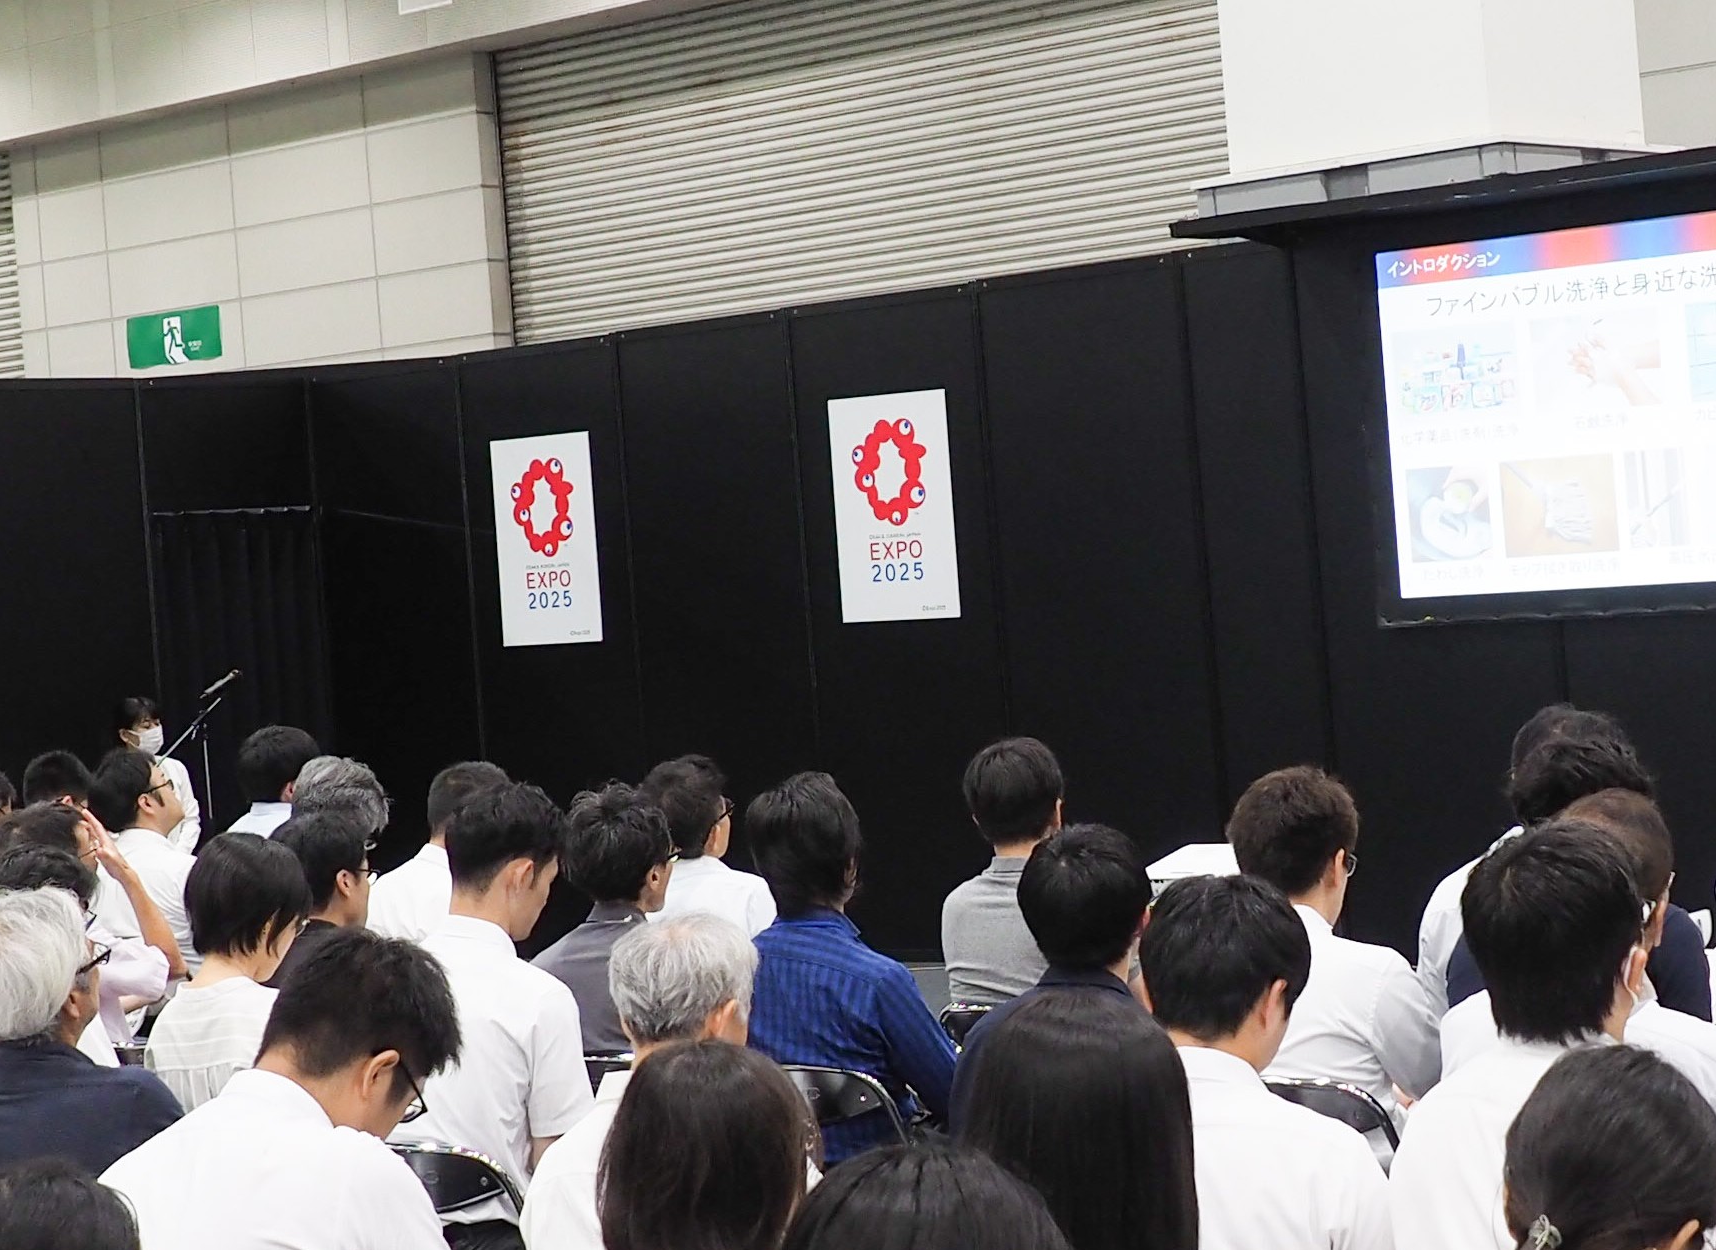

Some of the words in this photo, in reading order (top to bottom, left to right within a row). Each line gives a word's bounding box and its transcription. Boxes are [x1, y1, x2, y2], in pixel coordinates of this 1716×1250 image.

[1386, 251, 1501, 278] イントロダクション
[870, 539, 923, 561] EXPO
[526, 569, 571, 589] EXPO
[871, 561, 924, 582] 2025
[528, 590, 573, 610] 2025
